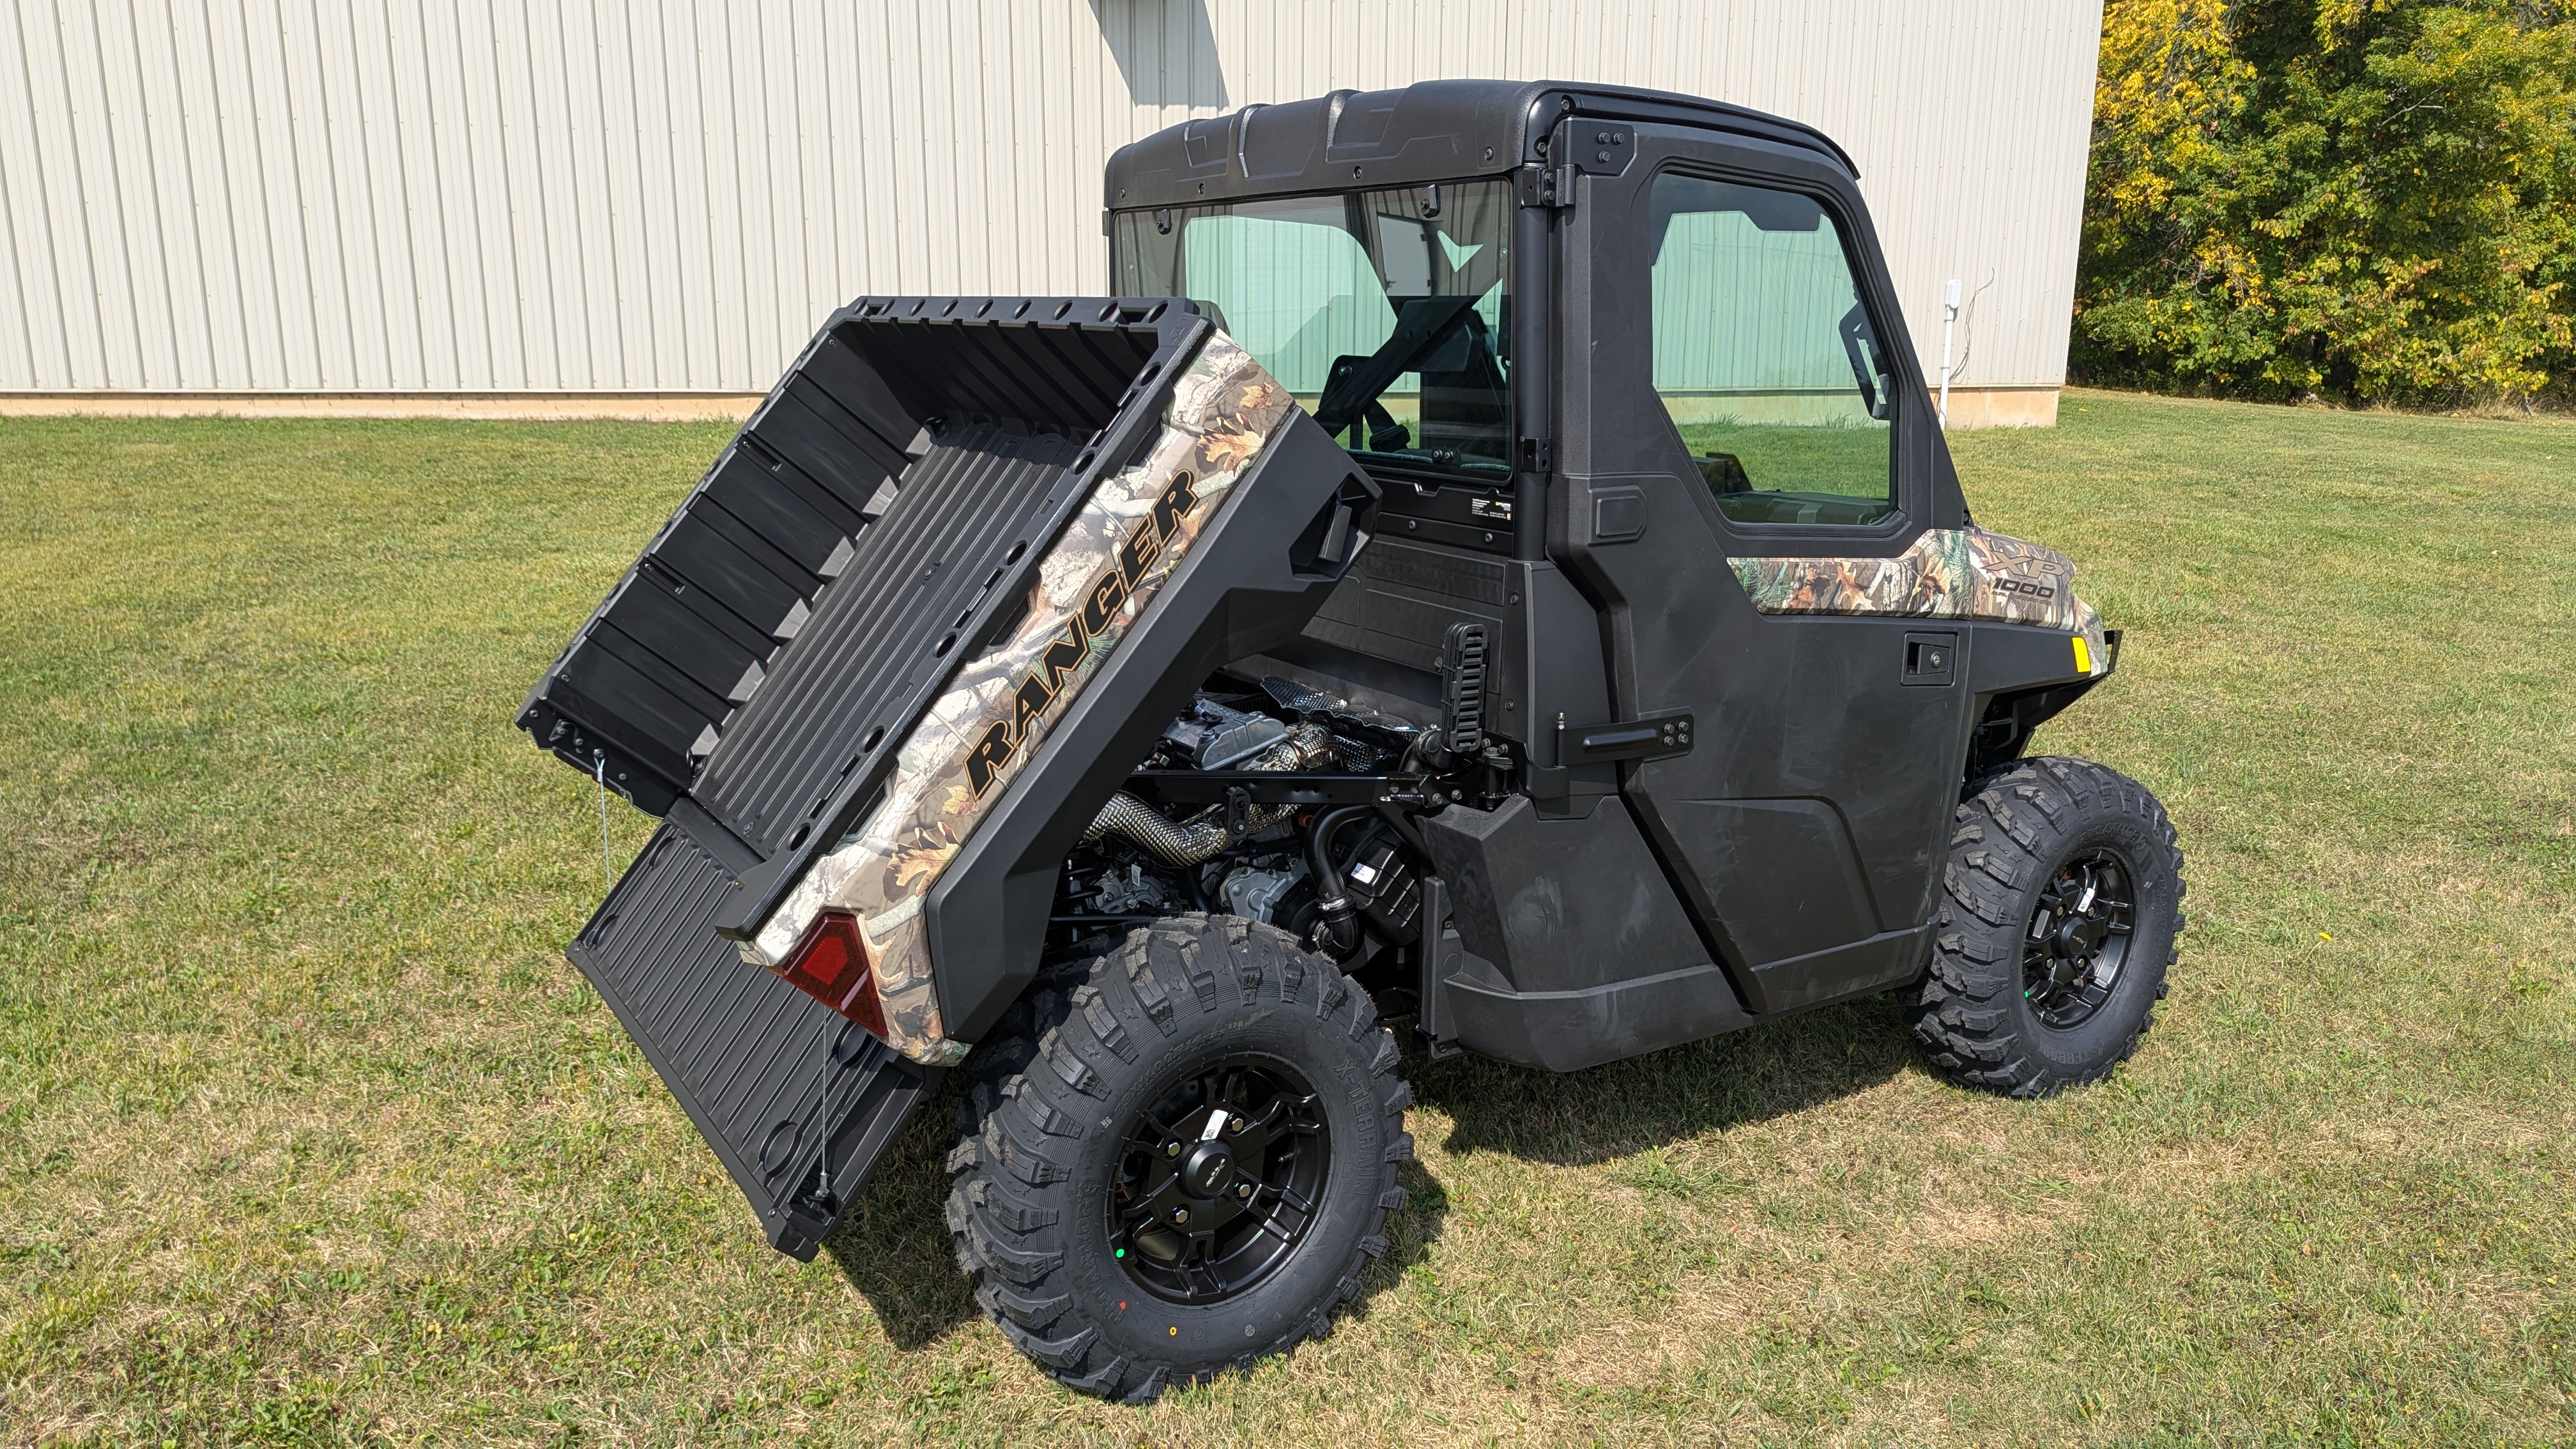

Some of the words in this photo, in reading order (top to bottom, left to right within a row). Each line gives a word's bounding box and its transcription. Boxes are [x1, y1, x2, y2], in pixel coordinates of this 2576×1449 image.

[1980, 549, 2066, 579] XP
[1993, 577, 2055, 599] 1000
[962, 468, 1200, 802] RANGER
[1332, 1055, 1377, 1195] X-TERRAIN
